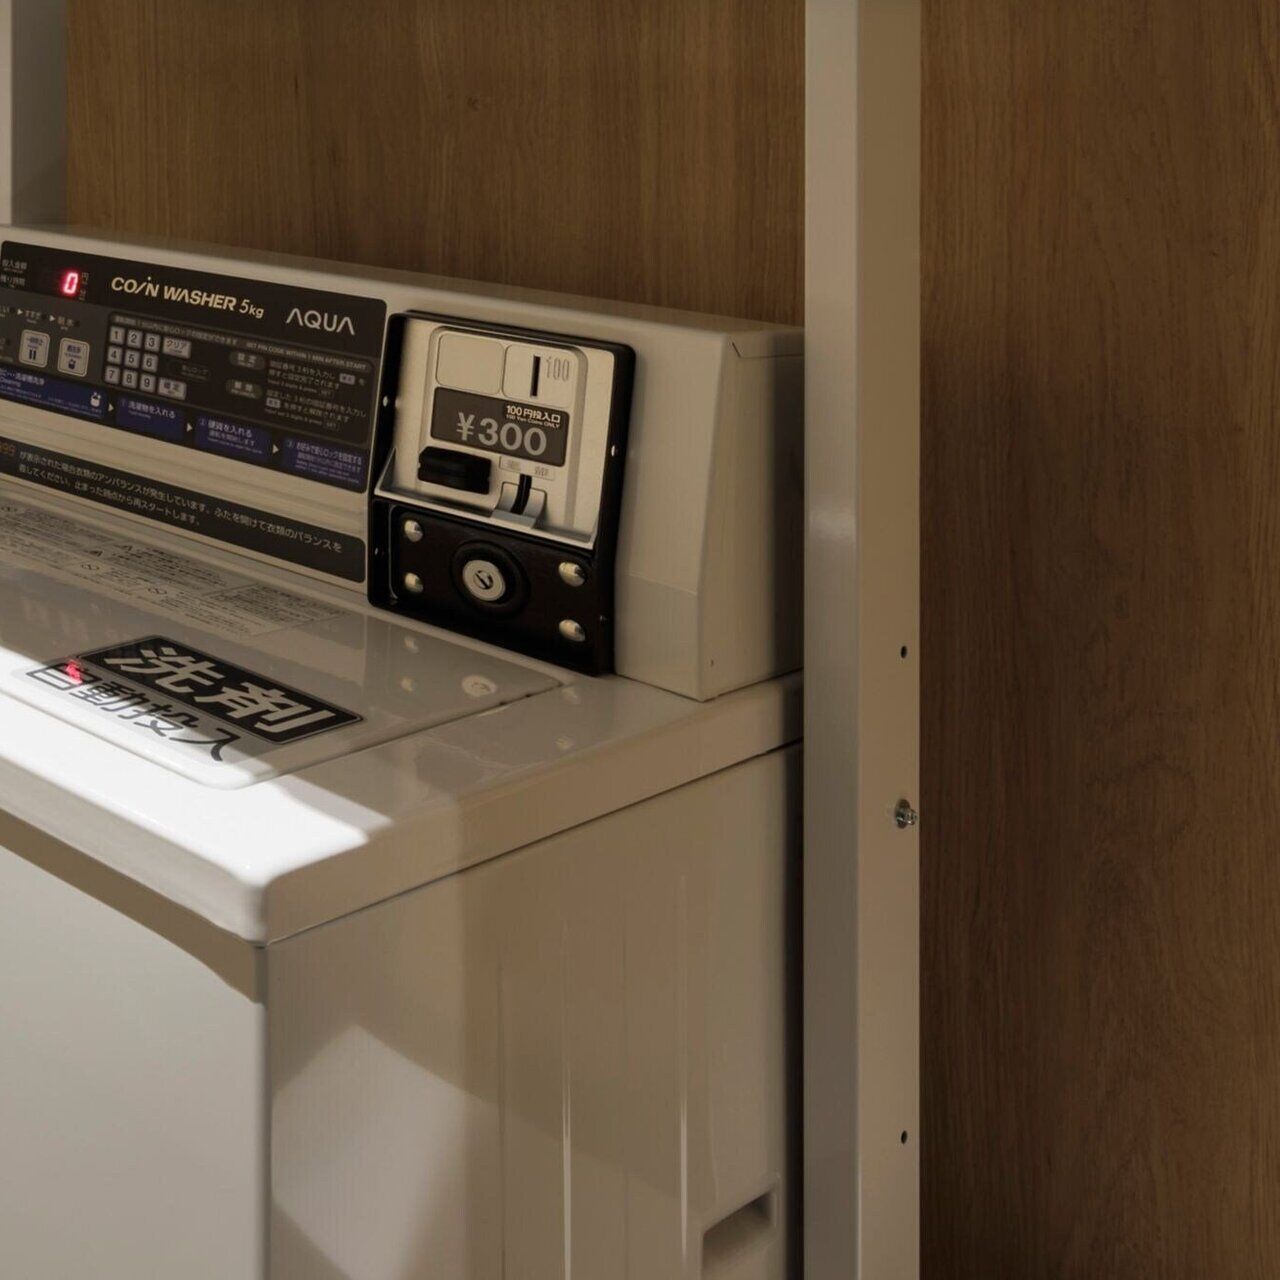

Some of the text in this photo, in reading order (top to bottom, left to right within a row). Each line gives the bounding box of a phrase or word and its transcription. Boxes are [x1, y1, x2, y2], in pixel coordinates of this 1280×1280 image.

[62, 271, 79, 295] 0
[111, 276, 356, 336] COIN WASHER 5kg AQUA
[456, 411, 547, 456] ¥300
[506, 405, 561, 424] 100円投入口
[31, 660, 241, 762] 自動投入
[103, 646, 336, 734] 洗剤
